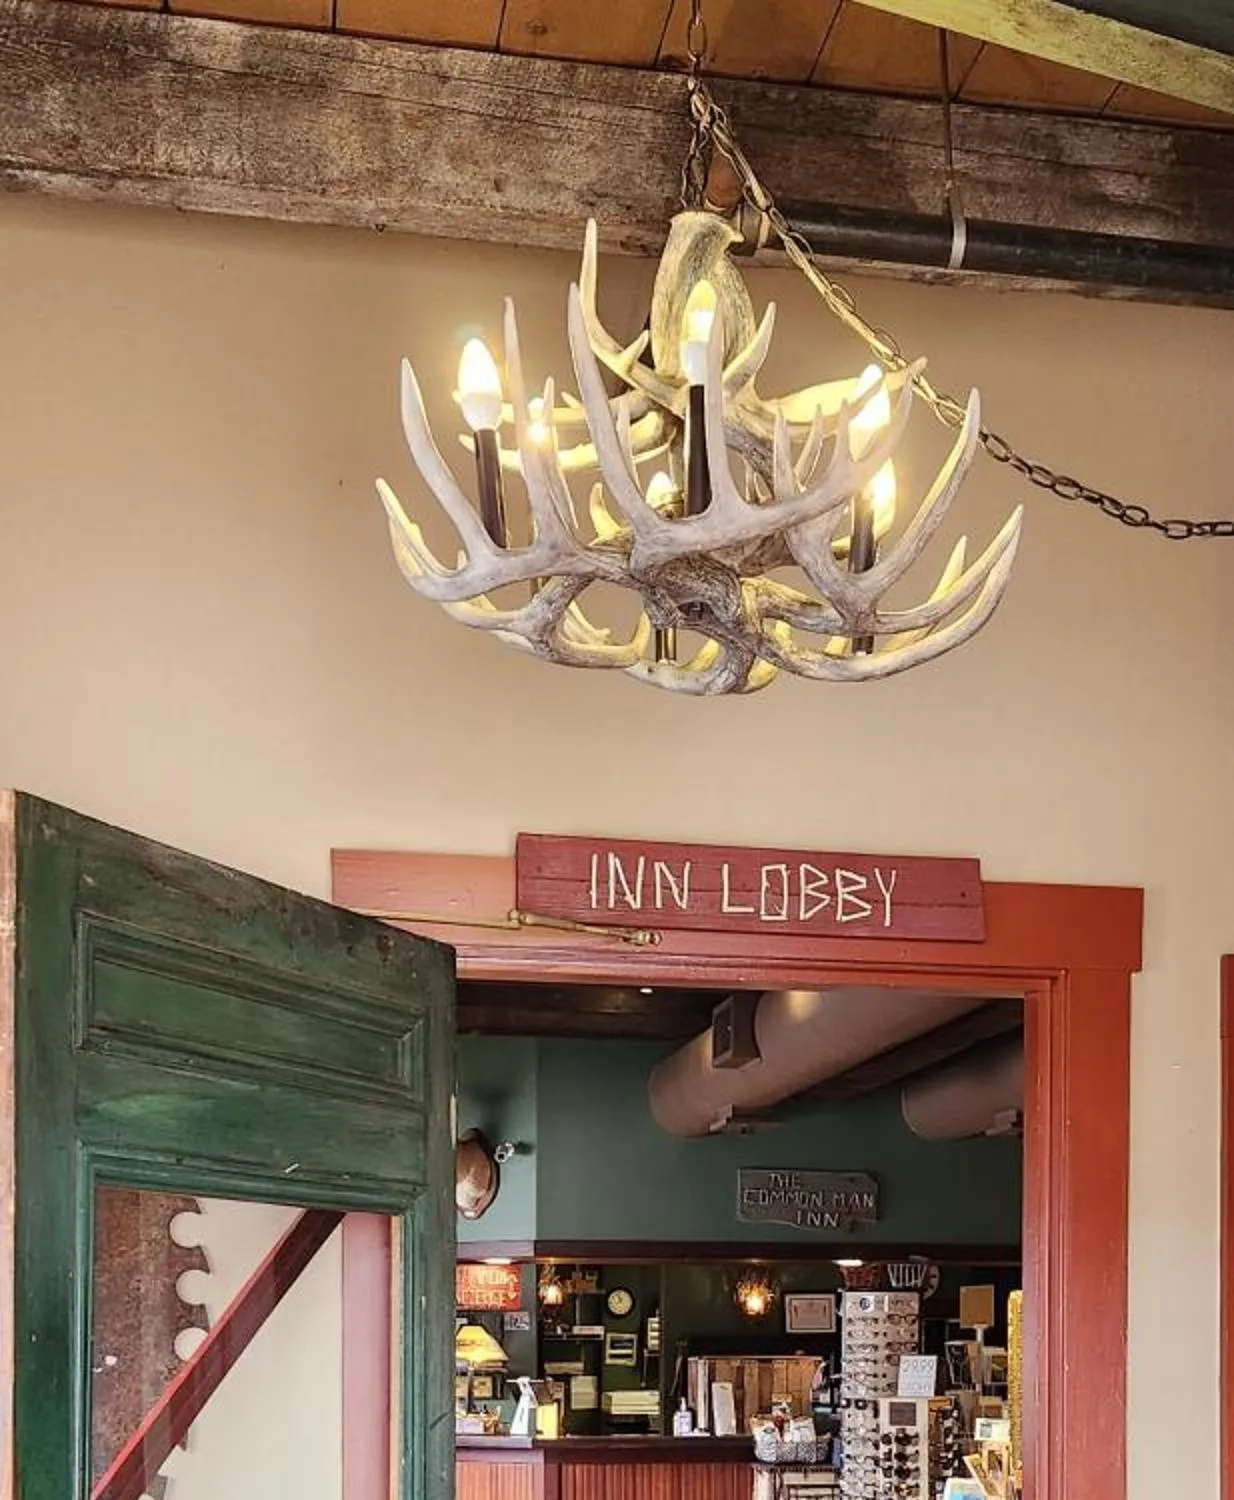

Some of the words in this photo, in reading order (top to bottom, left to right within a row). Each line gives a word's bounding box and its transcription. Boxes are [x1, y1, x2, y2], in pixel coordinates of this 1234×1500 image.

[589, 852, 691, 909] INN
[721, 863, 896, 926] LOBBY
[769, 1172, 801, 1188] THE
[743, 1188, 823, 1208] COMMON
[832, 1192, 874, 1208] MAN
[796, 1210, 840, 1228] INN
